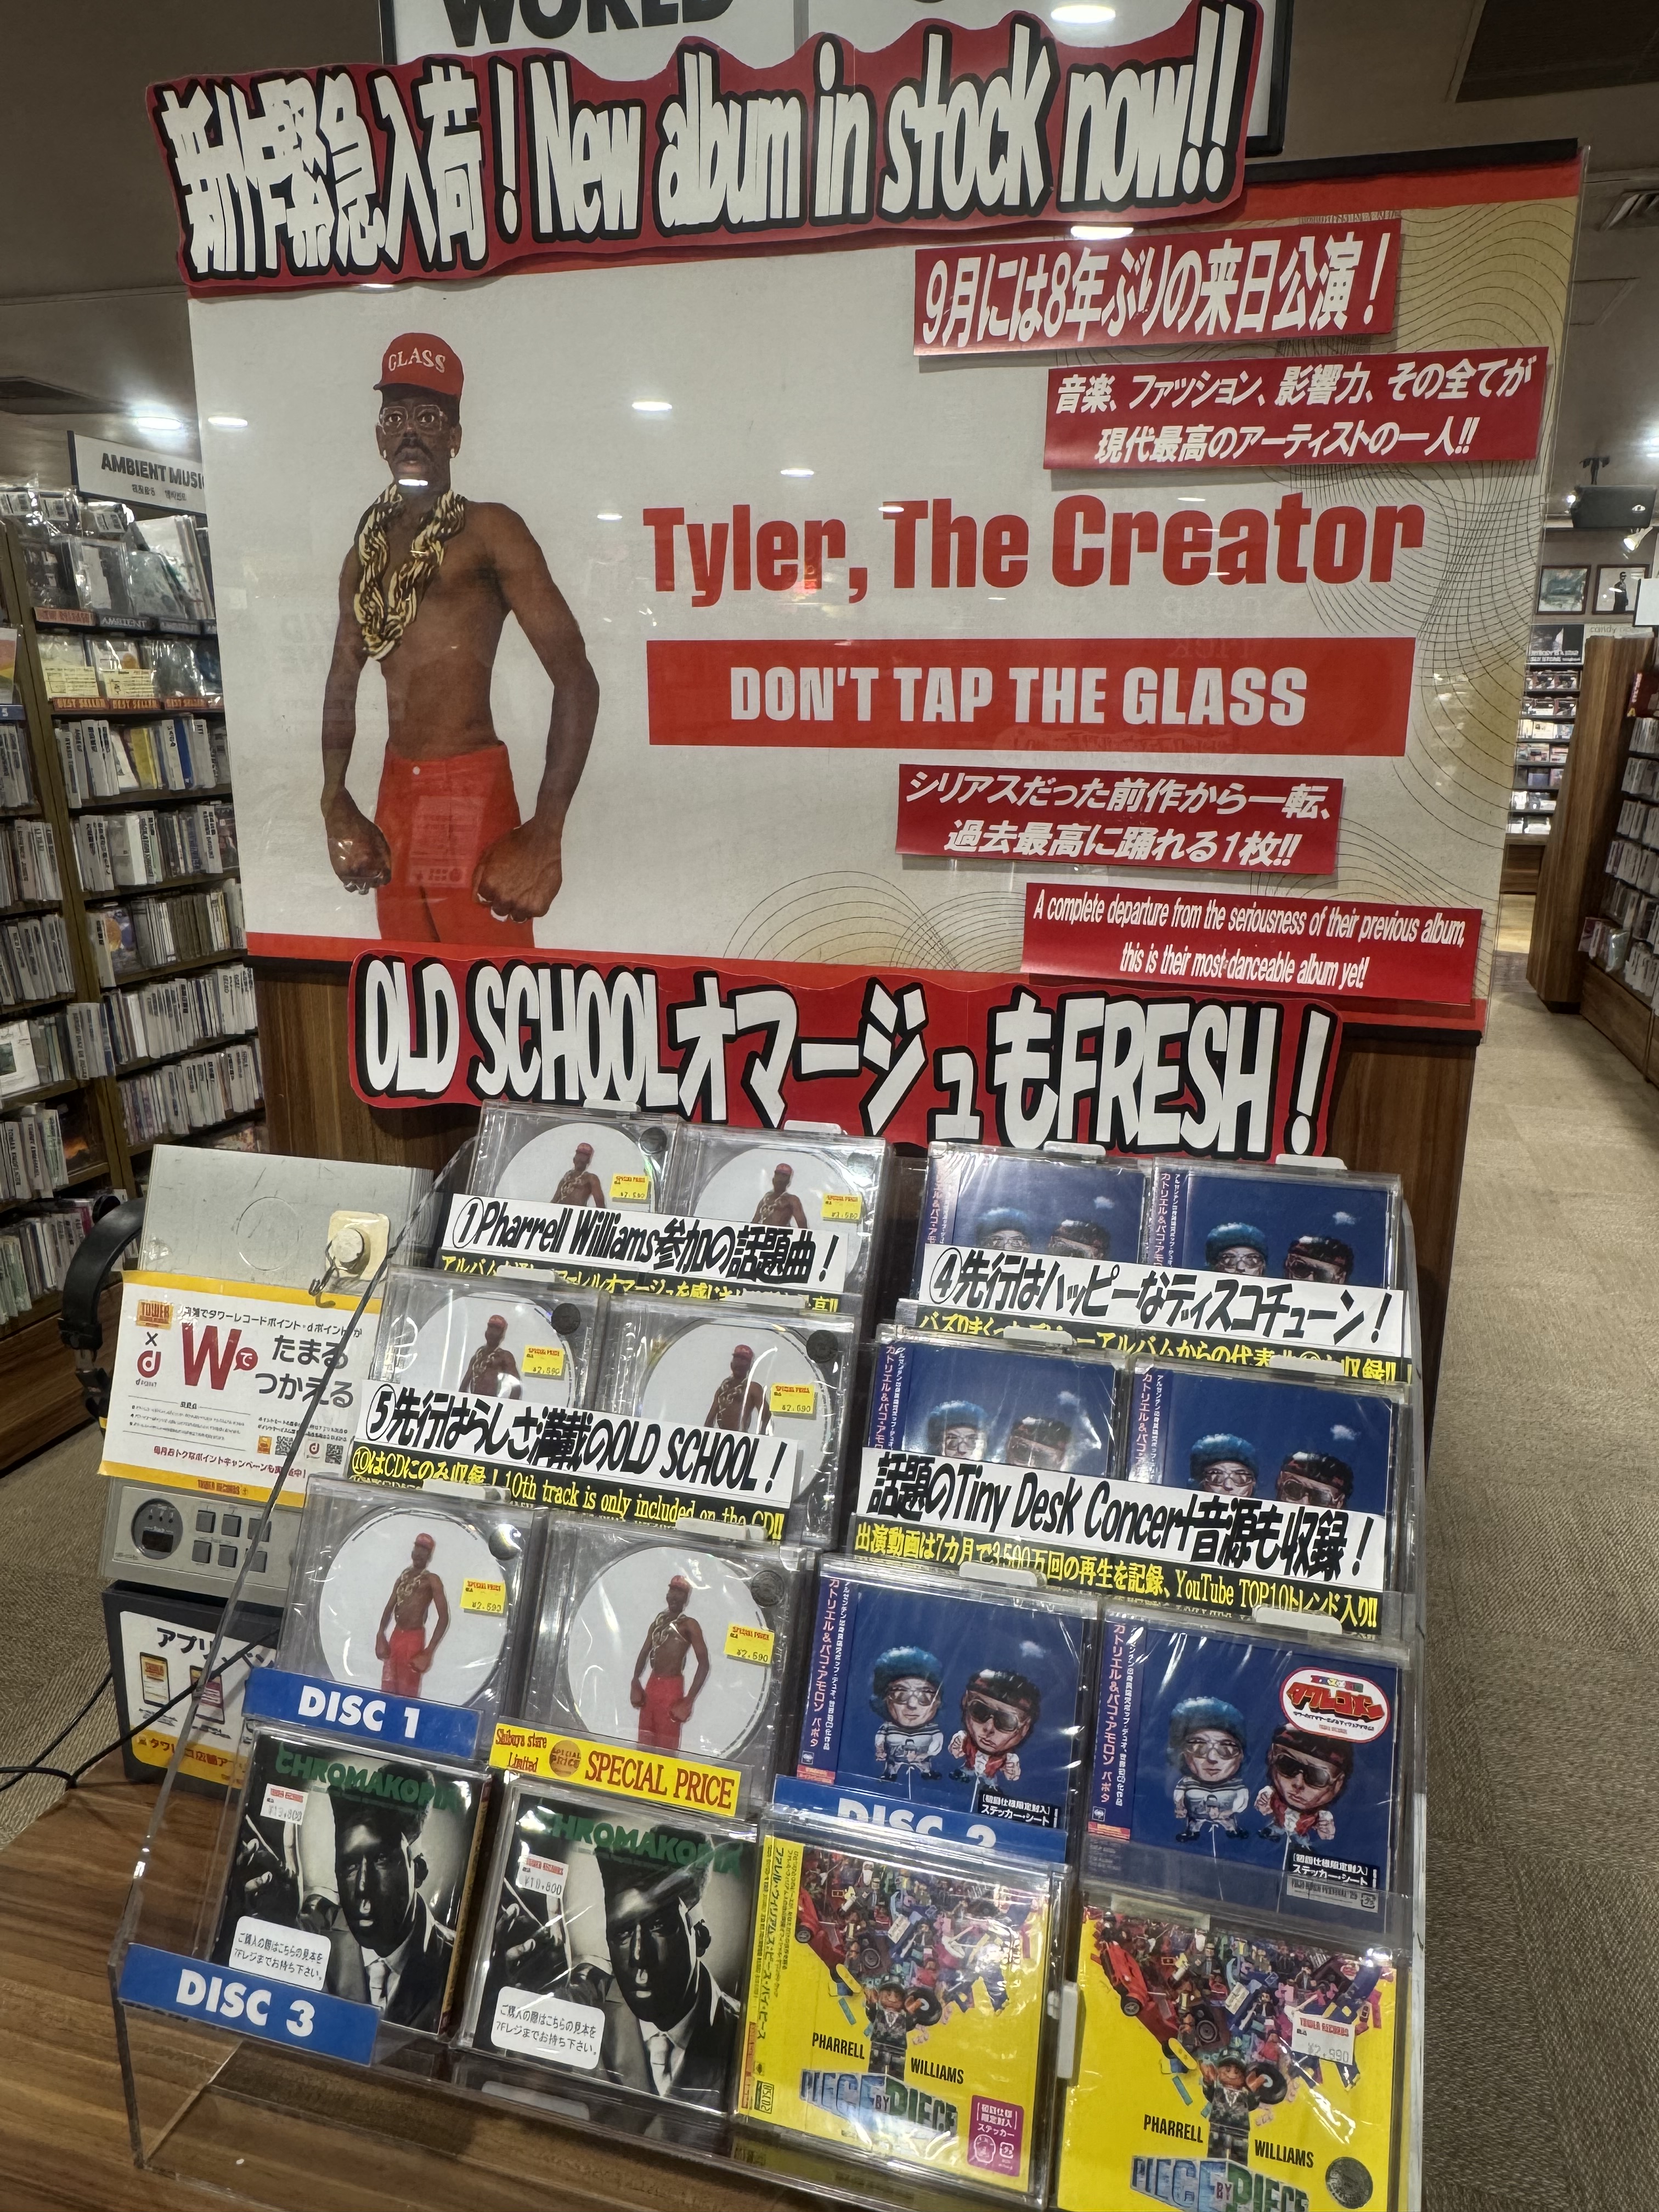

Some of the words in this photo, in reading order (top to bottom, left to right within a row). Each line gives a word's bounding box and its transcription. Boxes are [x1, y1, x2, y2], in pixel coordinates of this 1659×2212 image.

[529, 60, 641, 234] New
[659, 51, 801, 226] album
[814, 41, 869, 217] in
[882, 23, 1052, 213] stock
[1059, 4, 1245, 202] now!!
[388, 347, 445, 373] GLASS
[101, 453, 167, 482] AMBIENT
[642, 505, 868, 607] Tyler,
[882, 498, 1030, 589] The
[1052, 493, 1425, 588] Creator
[730, 666, 879, 722] DON'T
[893, 666, 994, 724] TAP
[1008, 667, 1106, 724] THE
[1122, 667, 1308, 727] GLASS
[1034, 889, 1044, 919] A
[1048, 893, 1104, 923] complete
[1107, 893, 1170, 928] departure
[1171, 899, 1203, 929] from
[1205, 900, 1226, 930] the
[1228, 907, 1305, 936] seriousness
[1308, 905, 1329, 936] of
[1325, 907, 1359, 940] their
[1358, 911, 1419, 943] previous
[1420, 912, 1465, 948] album,
[1120, 941, 1143, 973] this
[1146, 945, 1158, 974] is
[1160, 944, 1192, 977] their
[1297, 953, 1339, 987] album
[1338, 956, 1370, 991] yet!
[365, 959, 459, 1093] OLD
[182, 1322, 242, 1391] W
[271, 1335, 348, 1369] たまる
[255, 1373, 353, 1408] つかえる
[505, 1470, 537, 1500] 10th
[542, 1480, 579, 1508] track
[583, 1485, 596, 1509] is
[601, 1488, 632, 1519] only
[634, 1493, 696, 1523] included
[1012, 1472, 1083, 1534] Desk
[855, 1521, 1171, 1599] 出演動画は7カ月で3500万回の再生を記録、
[1175, 1568, 1234, 1606] YouTube
[298, 1685, 386, 1732] DISC
[405, 1707, 420, 1739] 1
[507, 1752, 538, 1773] Limited
[584, 1750, 668, 1796] SPECIAL
[673, 1768, 735, 1809] PRICE
[175, 1968, 272, 2026] DISC
[286, 2000, 315, 2038] 3
[811, 2031, 865, 2059] PHARRELL
[910, 2057, 964, 2084] WILLIAMS
[876, 2094, 890, 2112] BY
[1143, 2114, 1204, 2143] PHARRELL
[1254, 2139, 1314, 2168] WILLIAMS
[1216, 2181, 1233, 2201] BY
